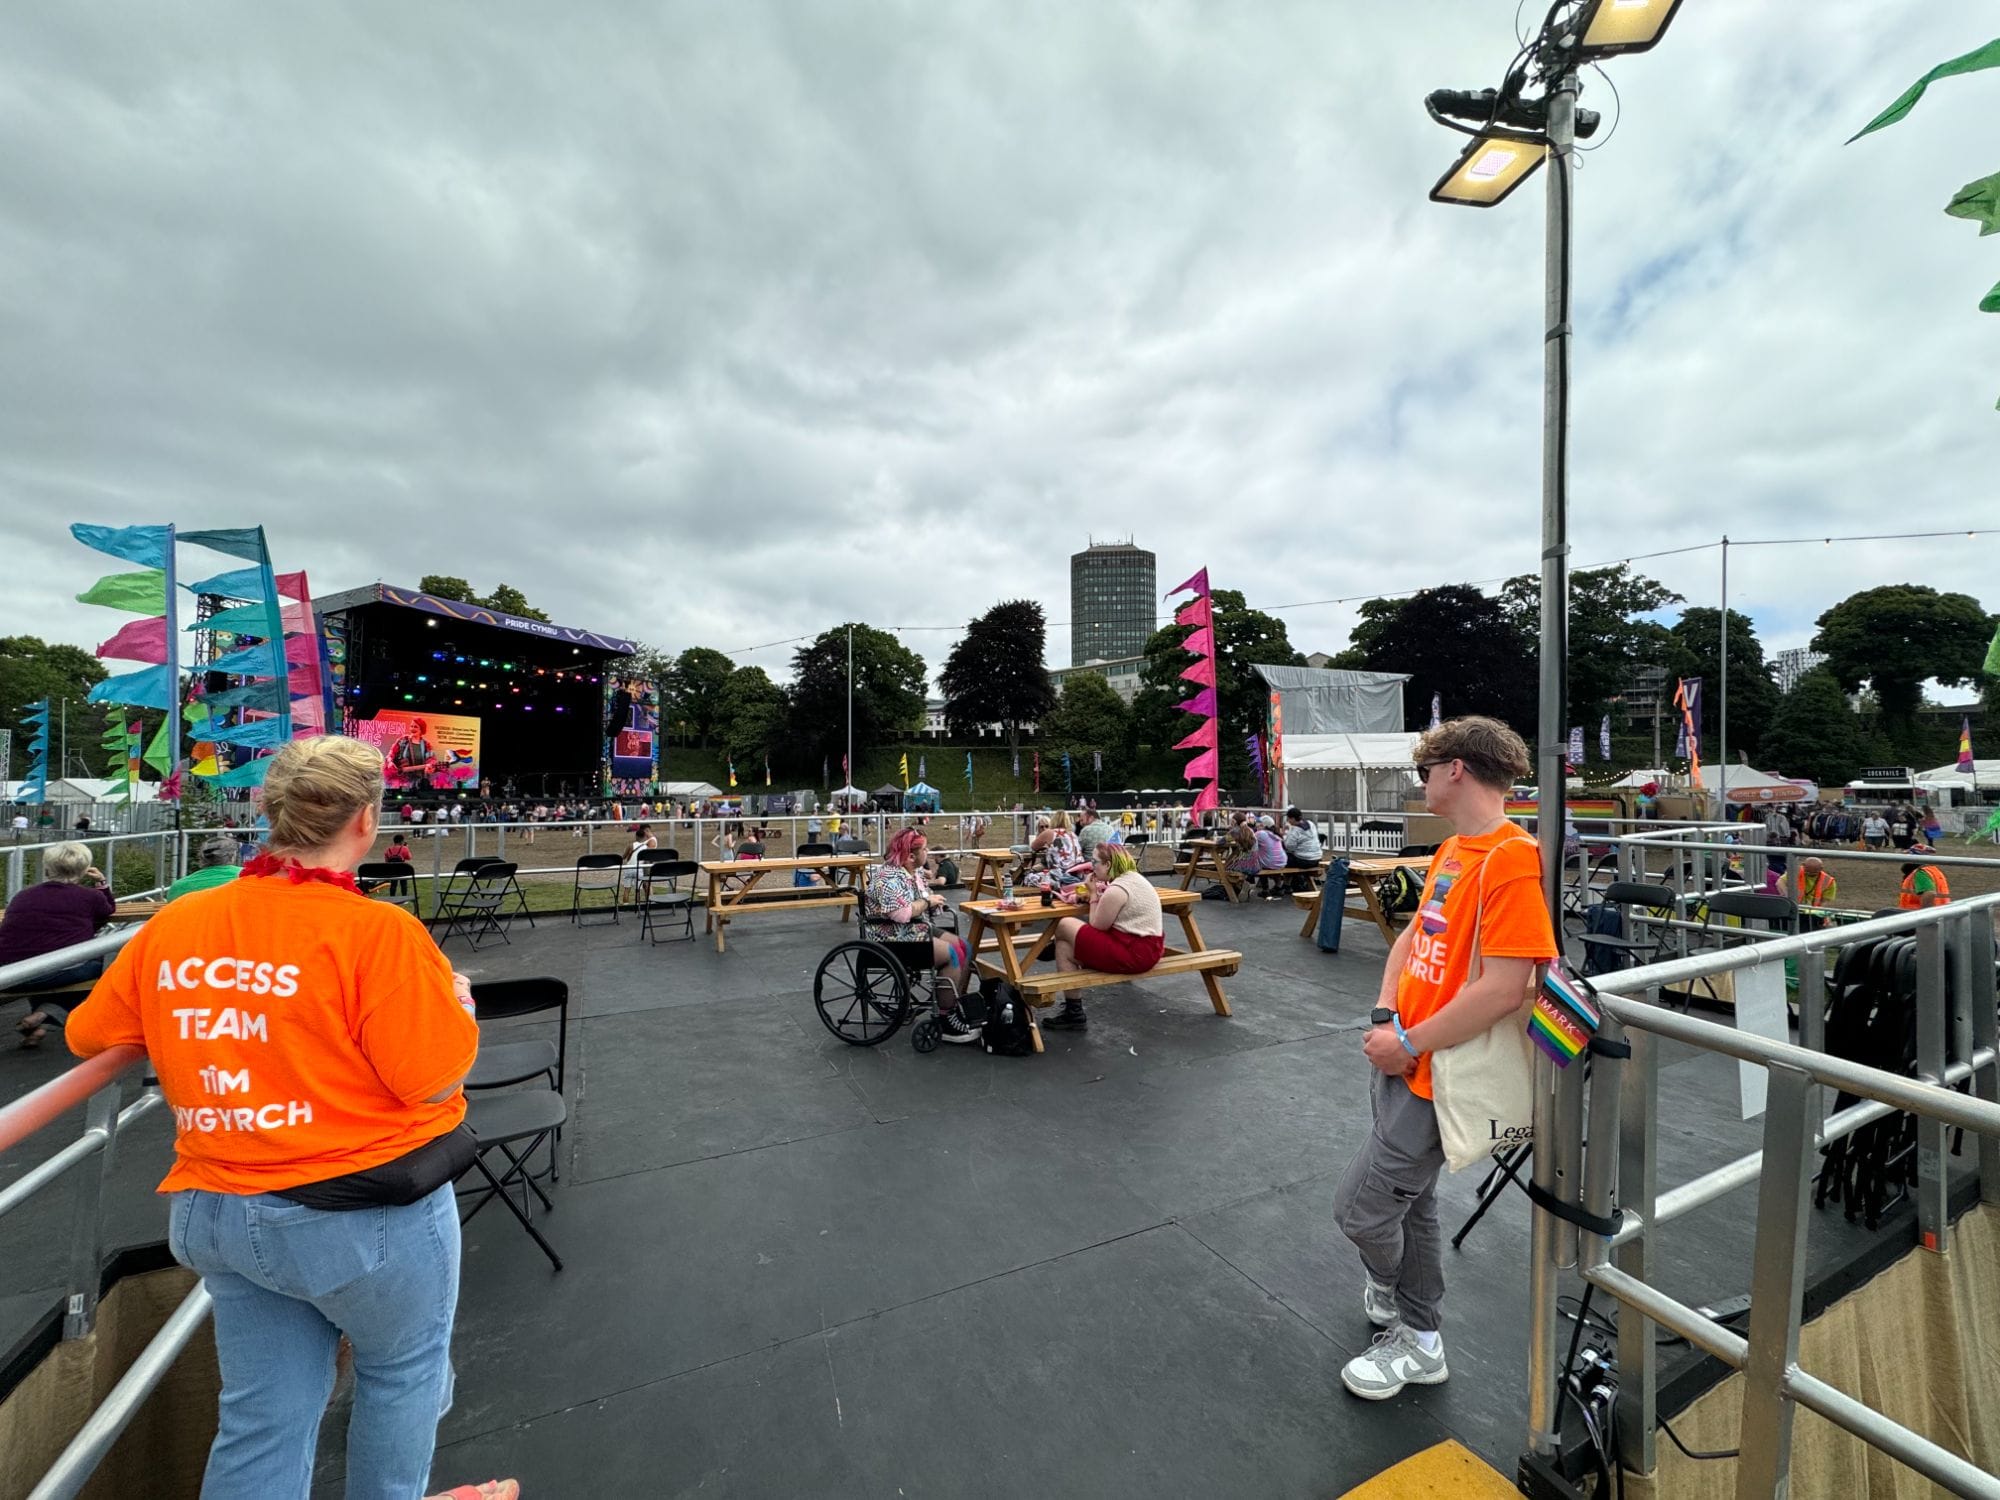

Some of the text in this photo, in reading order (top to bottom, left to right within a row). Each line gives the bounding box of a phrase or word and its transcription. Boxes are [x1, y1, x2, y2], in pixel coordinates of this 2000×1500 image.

[505, 618, 558, 635] PRIDE CYMRU
[157, 957, 300, 997] ACCESS
[172, 1007, 268, 1042] TEAM
